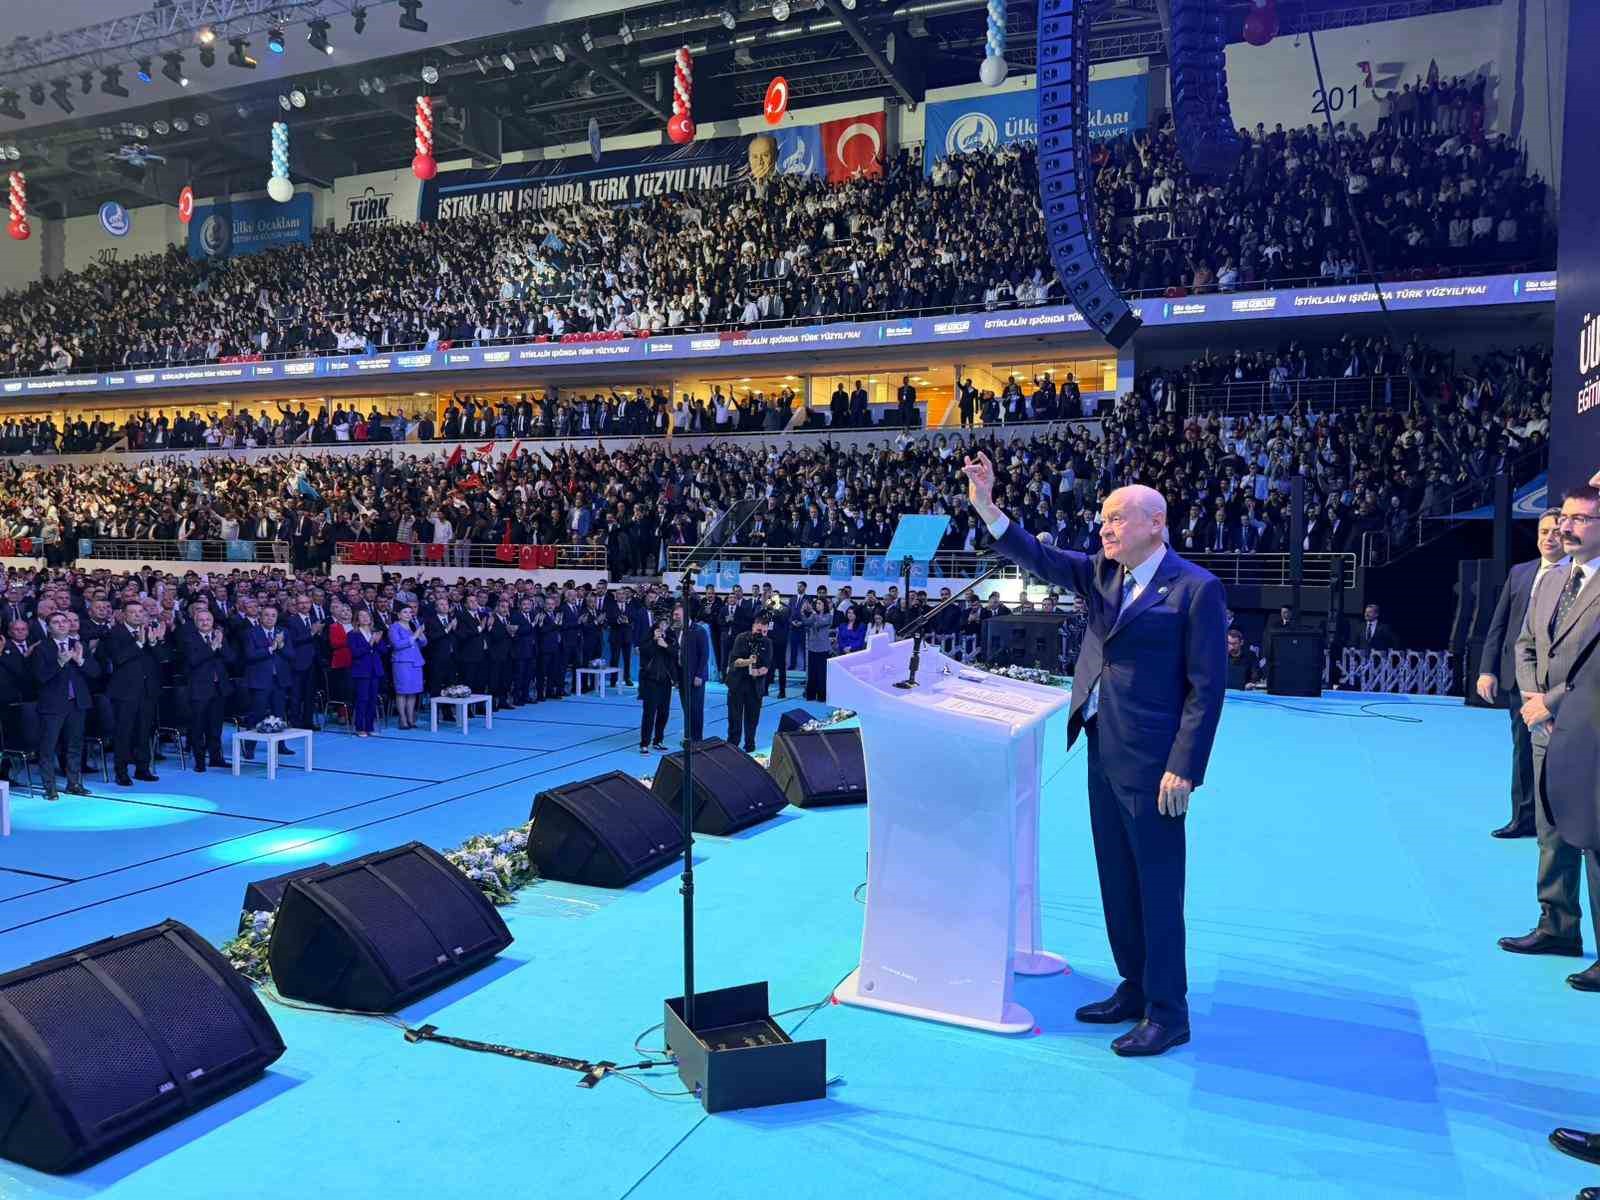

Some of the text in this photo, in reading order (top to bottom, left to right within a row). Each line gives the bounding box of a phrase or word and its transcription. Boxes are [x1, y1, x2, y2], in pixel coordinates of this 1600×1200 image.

[1311, 85, 1358, 113] 201
[589, 176, 630, 203] TÜRK
[634, 164, 731, 198] YÜZYILI'NA!
[350, 197, 390, 222] TÜRK
[1294, 295, 1347, 306] İSTİKLALİN
[1396, 290, 1423, 299] TÜRK
[1068, 312, 1084, 322] TÜR
